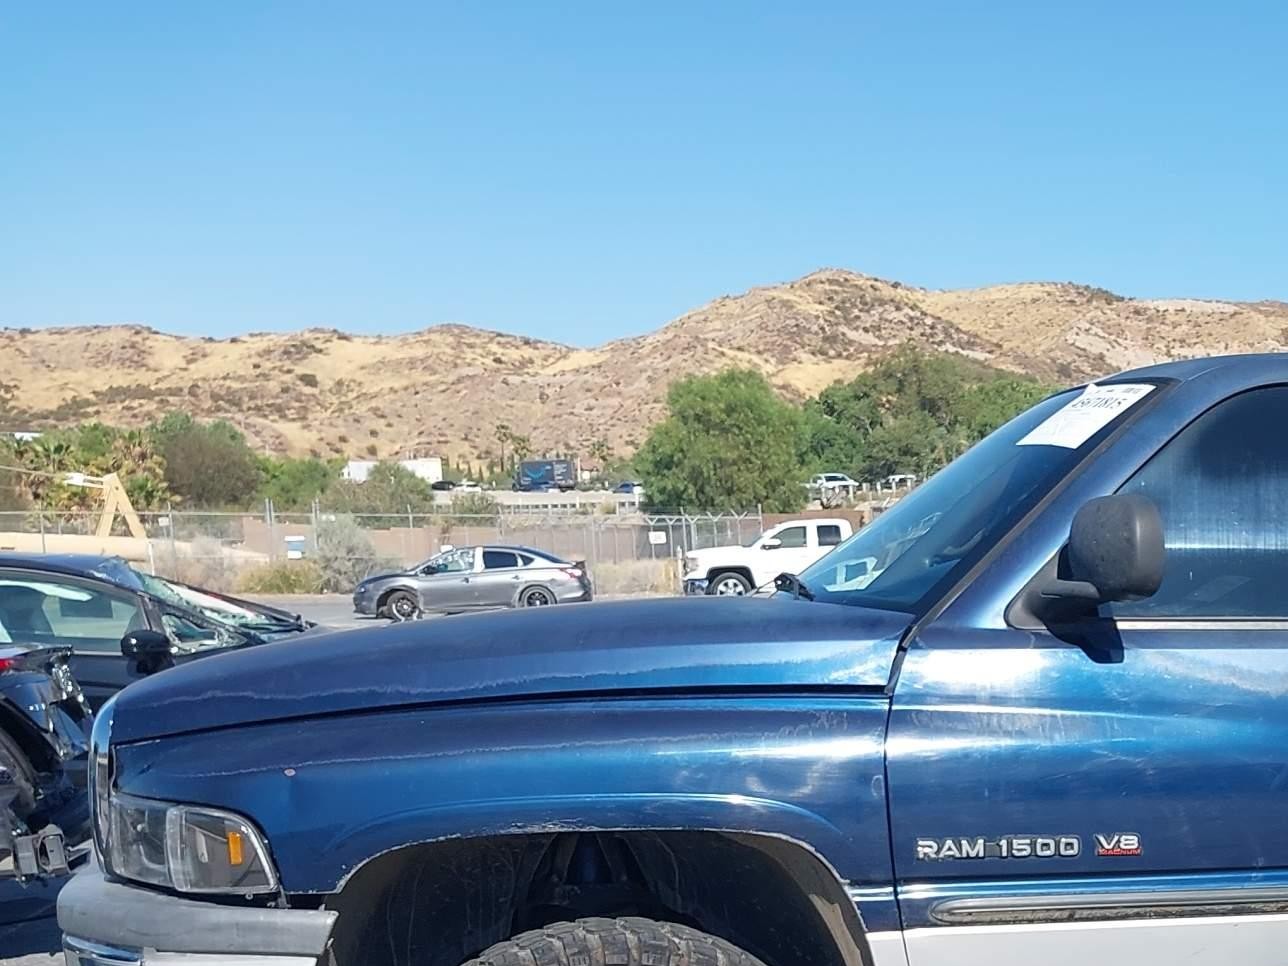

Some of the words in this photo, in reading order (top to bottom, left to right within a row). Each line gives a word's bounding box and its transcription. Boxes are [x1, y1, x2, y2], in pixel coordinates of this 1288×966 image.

[916, 838, 985, 858] RAM
[998, 837, 1080, 857] 1500
[1095, 834, 1139, 850] V8
